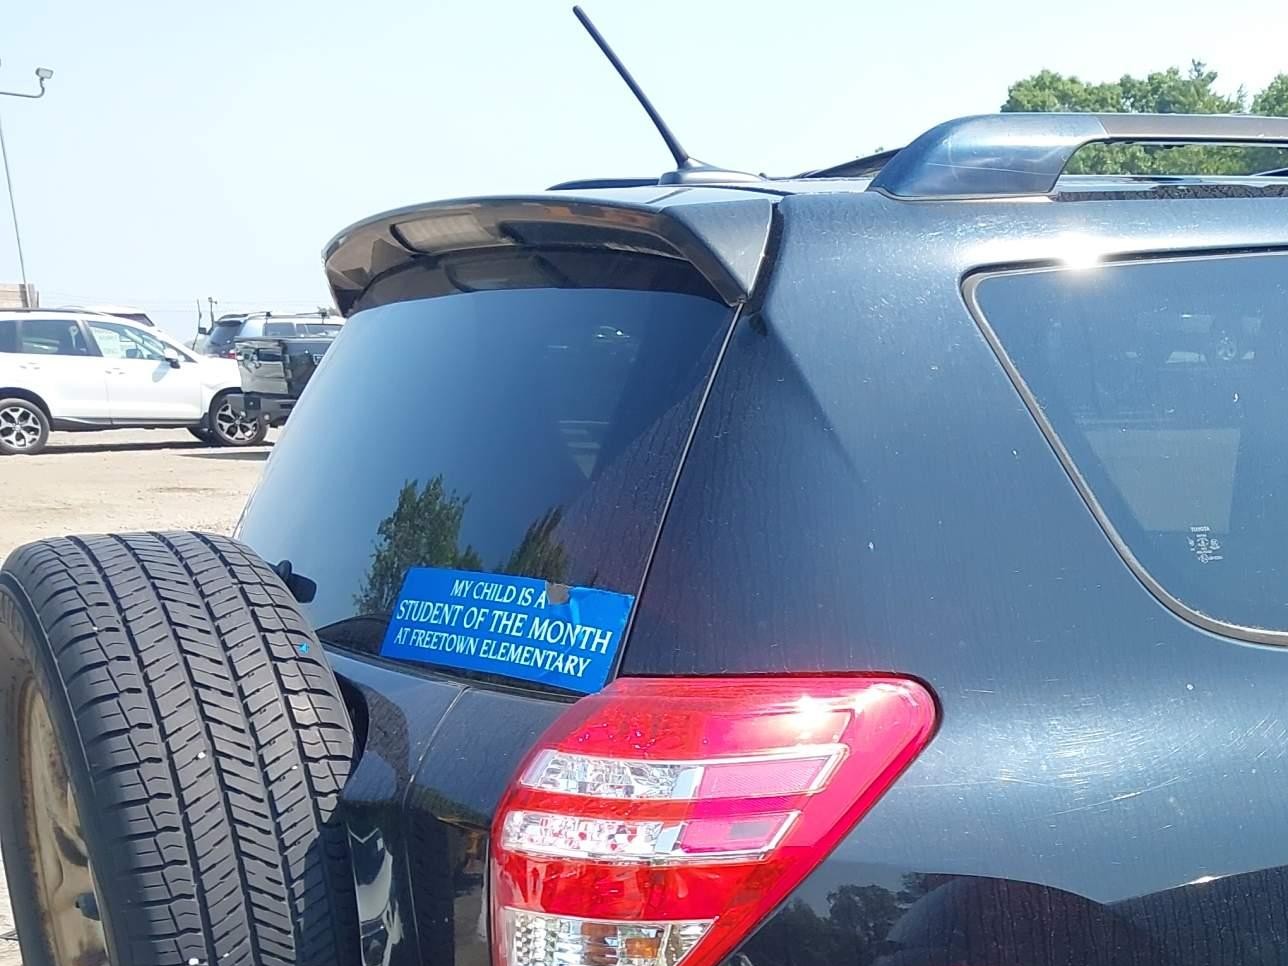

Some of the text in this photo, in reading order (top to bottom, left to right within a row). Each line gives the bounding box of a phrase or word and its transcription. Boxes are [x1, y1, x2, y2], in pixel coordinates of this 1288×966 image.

[451, 579, 547, 610] MY CHILD IS A
[394, 627, 592, 678] AT FREETOWN ELEMENTARY
[397, 599, 613, 655] STUDENT OF THE MONTH
